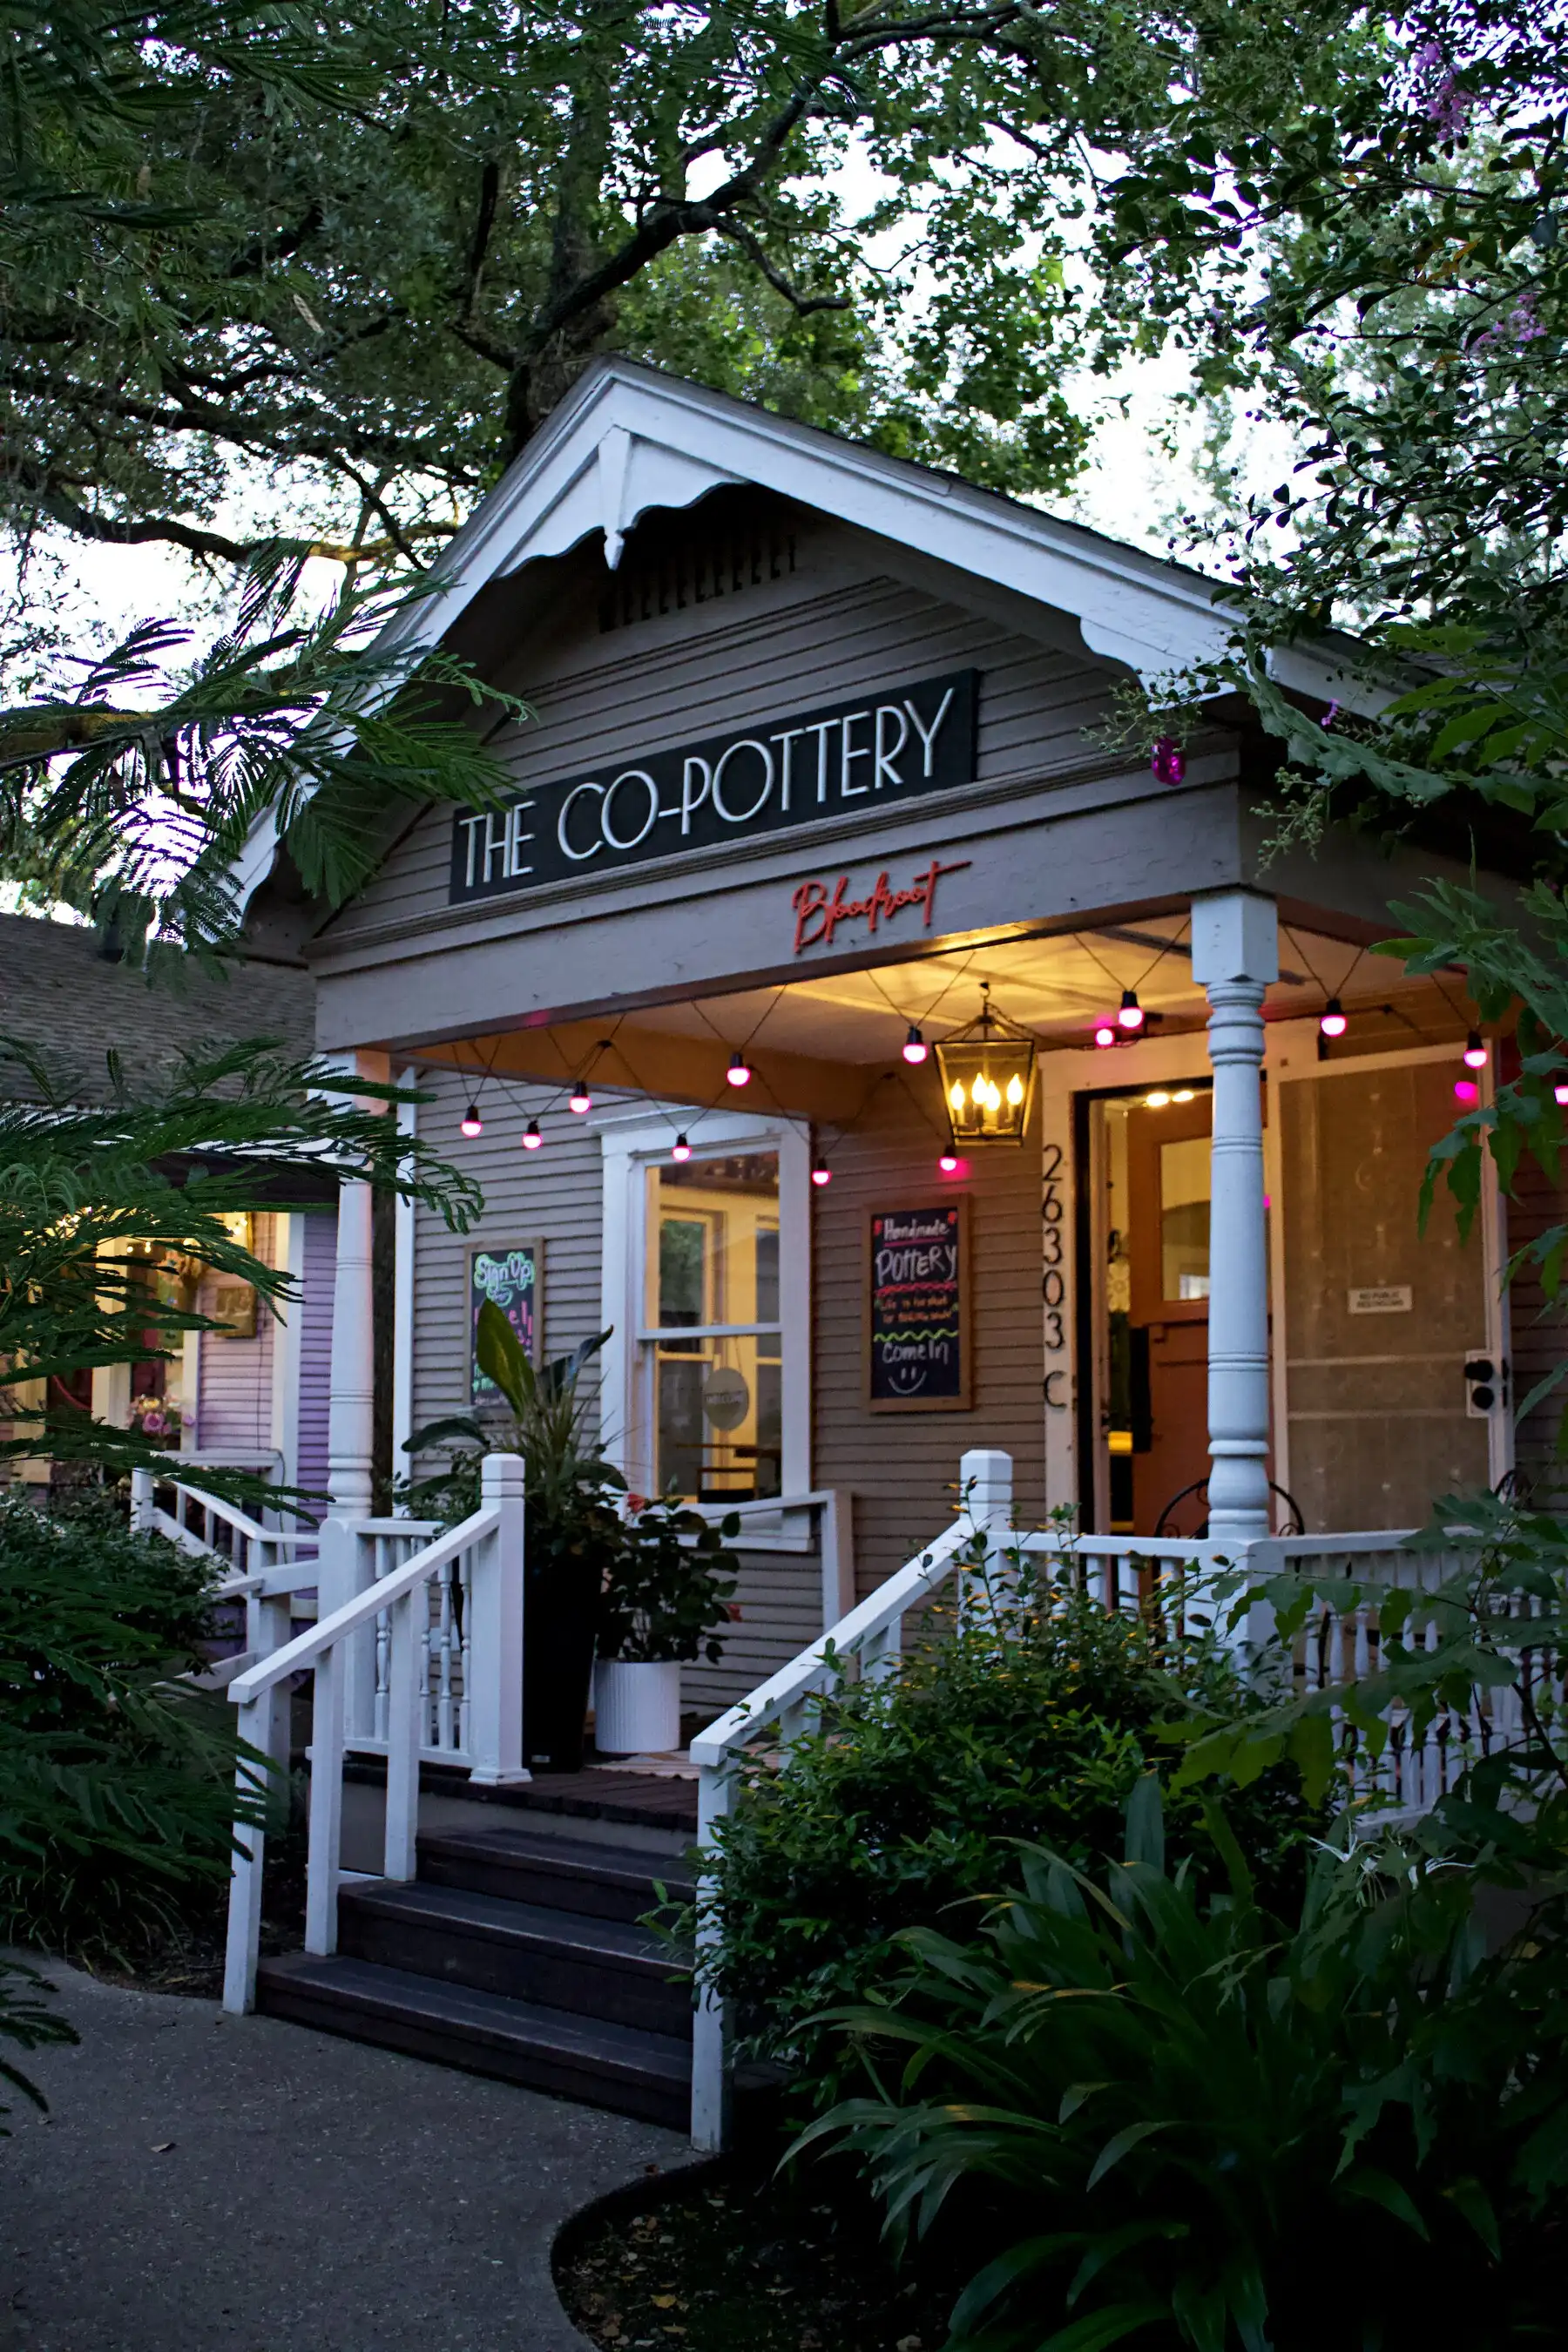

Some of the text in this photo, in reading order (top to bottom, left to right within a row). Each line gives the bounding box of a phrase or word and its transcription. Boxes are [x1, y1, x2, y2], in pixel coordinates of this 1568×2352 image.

[458, 688, 954, 887] THE CO-POTTERY
[791, 860, 972, 954] Bloodroot
[883, 1219, 950, 1240] Handmade
[476, 1257, 531, 1290] Sign Up
[882, 1342, 926, 1364] Come
